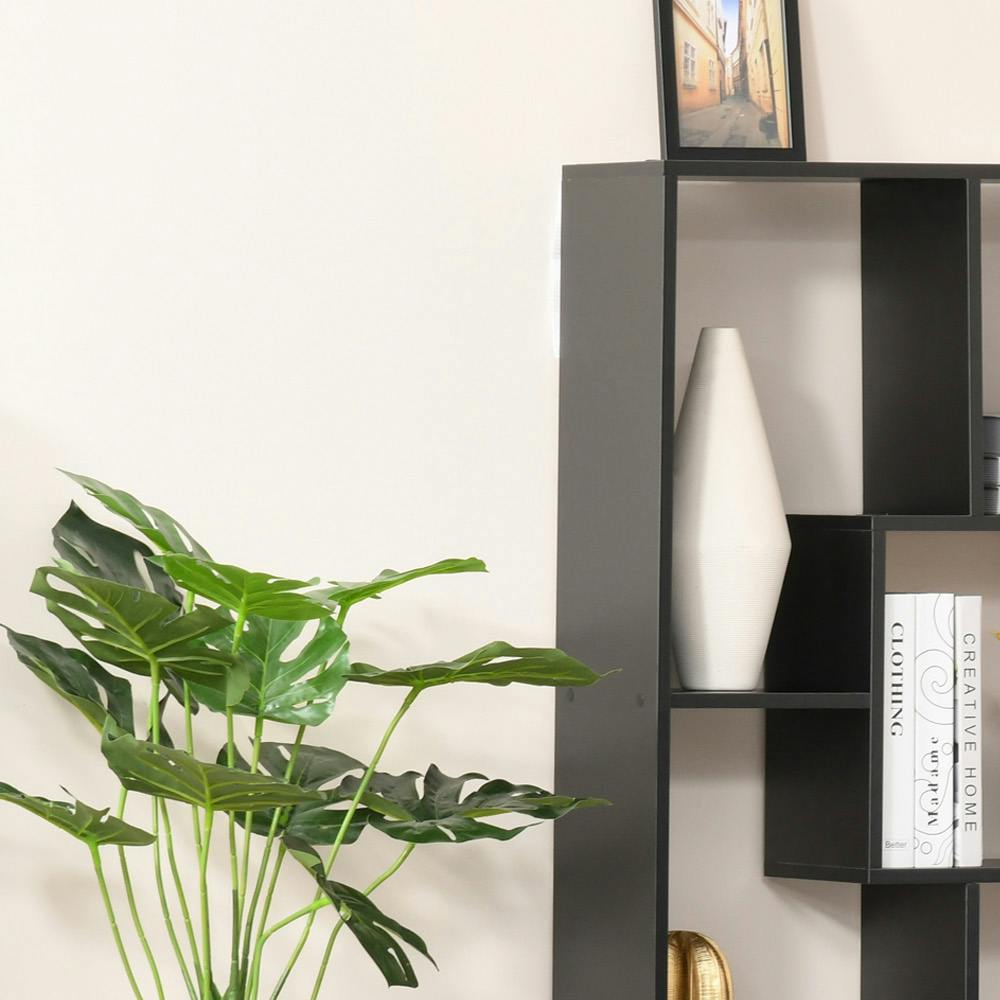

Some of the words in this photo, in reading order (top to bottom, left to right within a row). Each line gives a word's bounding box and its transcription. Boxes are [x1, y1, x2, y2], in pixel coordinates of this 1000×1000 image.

[890, 621, 904, 737] CLOTHING
[963, 633, 977, 752] CREATIVE
[927, 736, 939, 827] Madame
[964, 767, 977, 832] HOME
